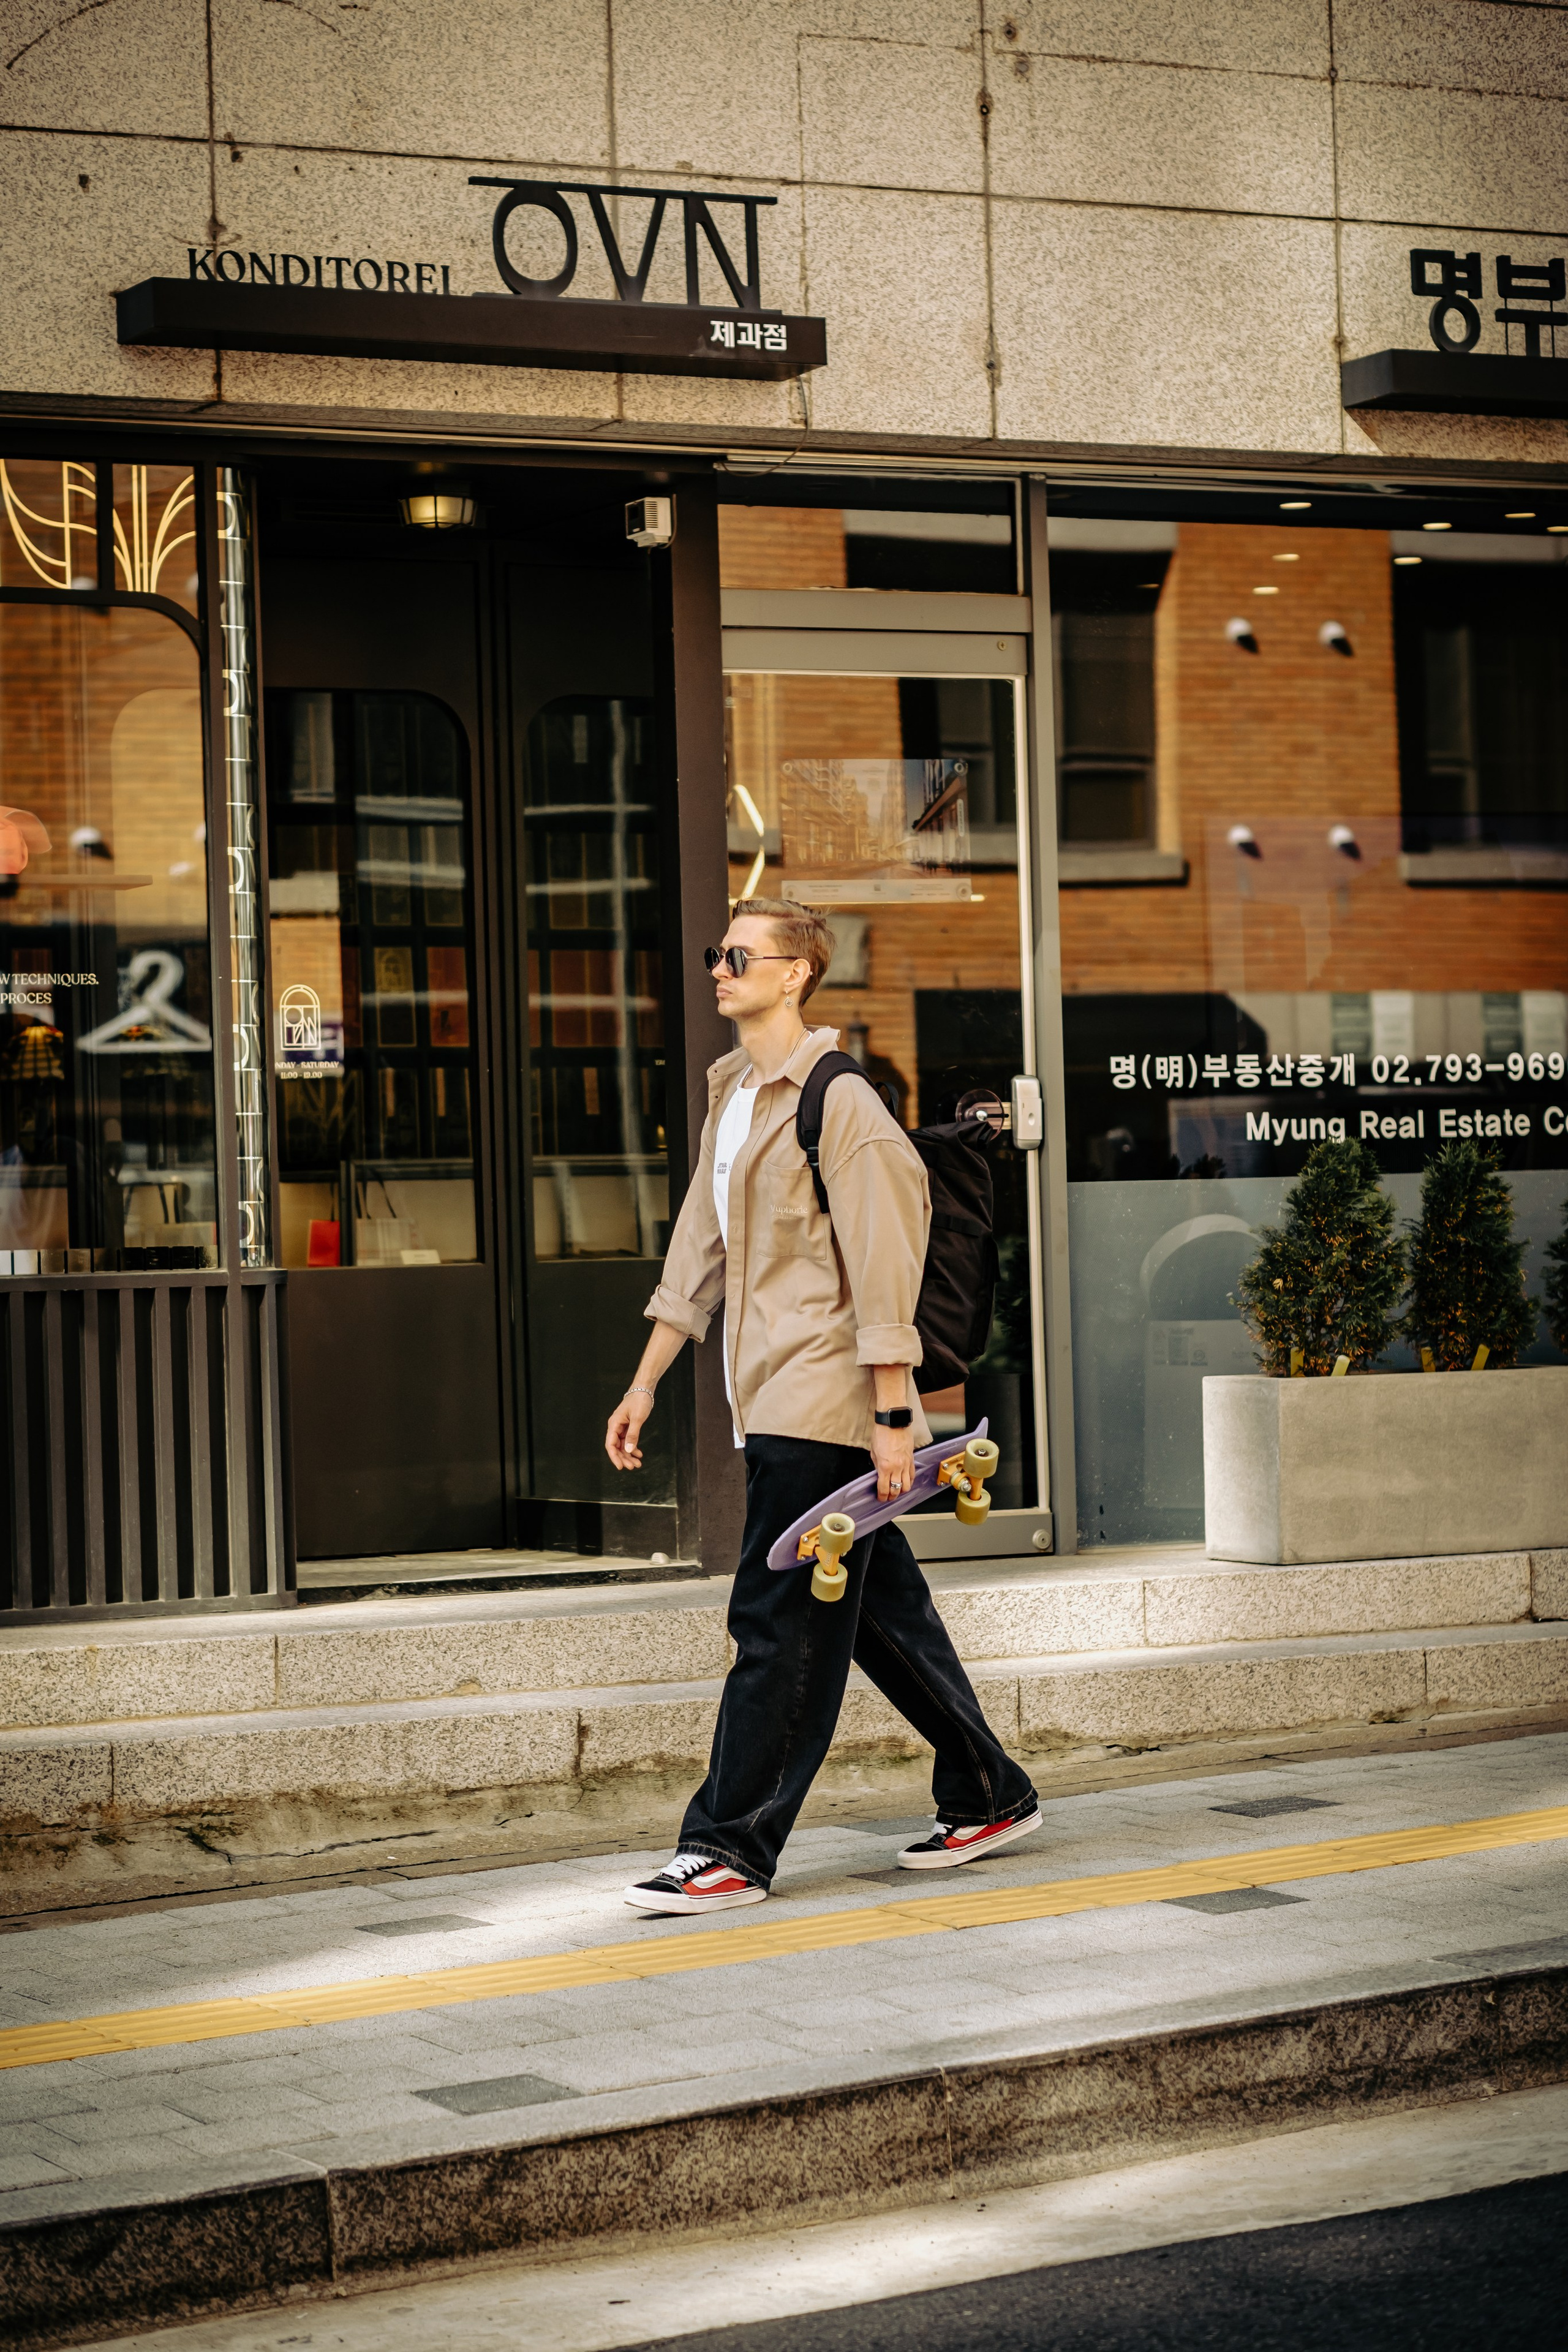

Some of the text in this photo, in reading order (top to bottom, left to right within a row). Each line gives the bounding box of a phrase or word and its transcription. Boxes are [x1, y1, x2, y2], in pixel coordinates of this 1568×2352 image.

[469, 176, 777, 309] OVN
[187, 248, 450, 295] KONDITOREI
[710, 320, 787, 351] 제과점
[1, 992, 52, 1005] PROCES
[12, 973, 99, 987] TECHNIQUES.
[1109, 1052, 1568, 1090] 명(明)부동산중개 02.793-969
[1246, 1106, 1568, 1146] Myung Real Estate C
